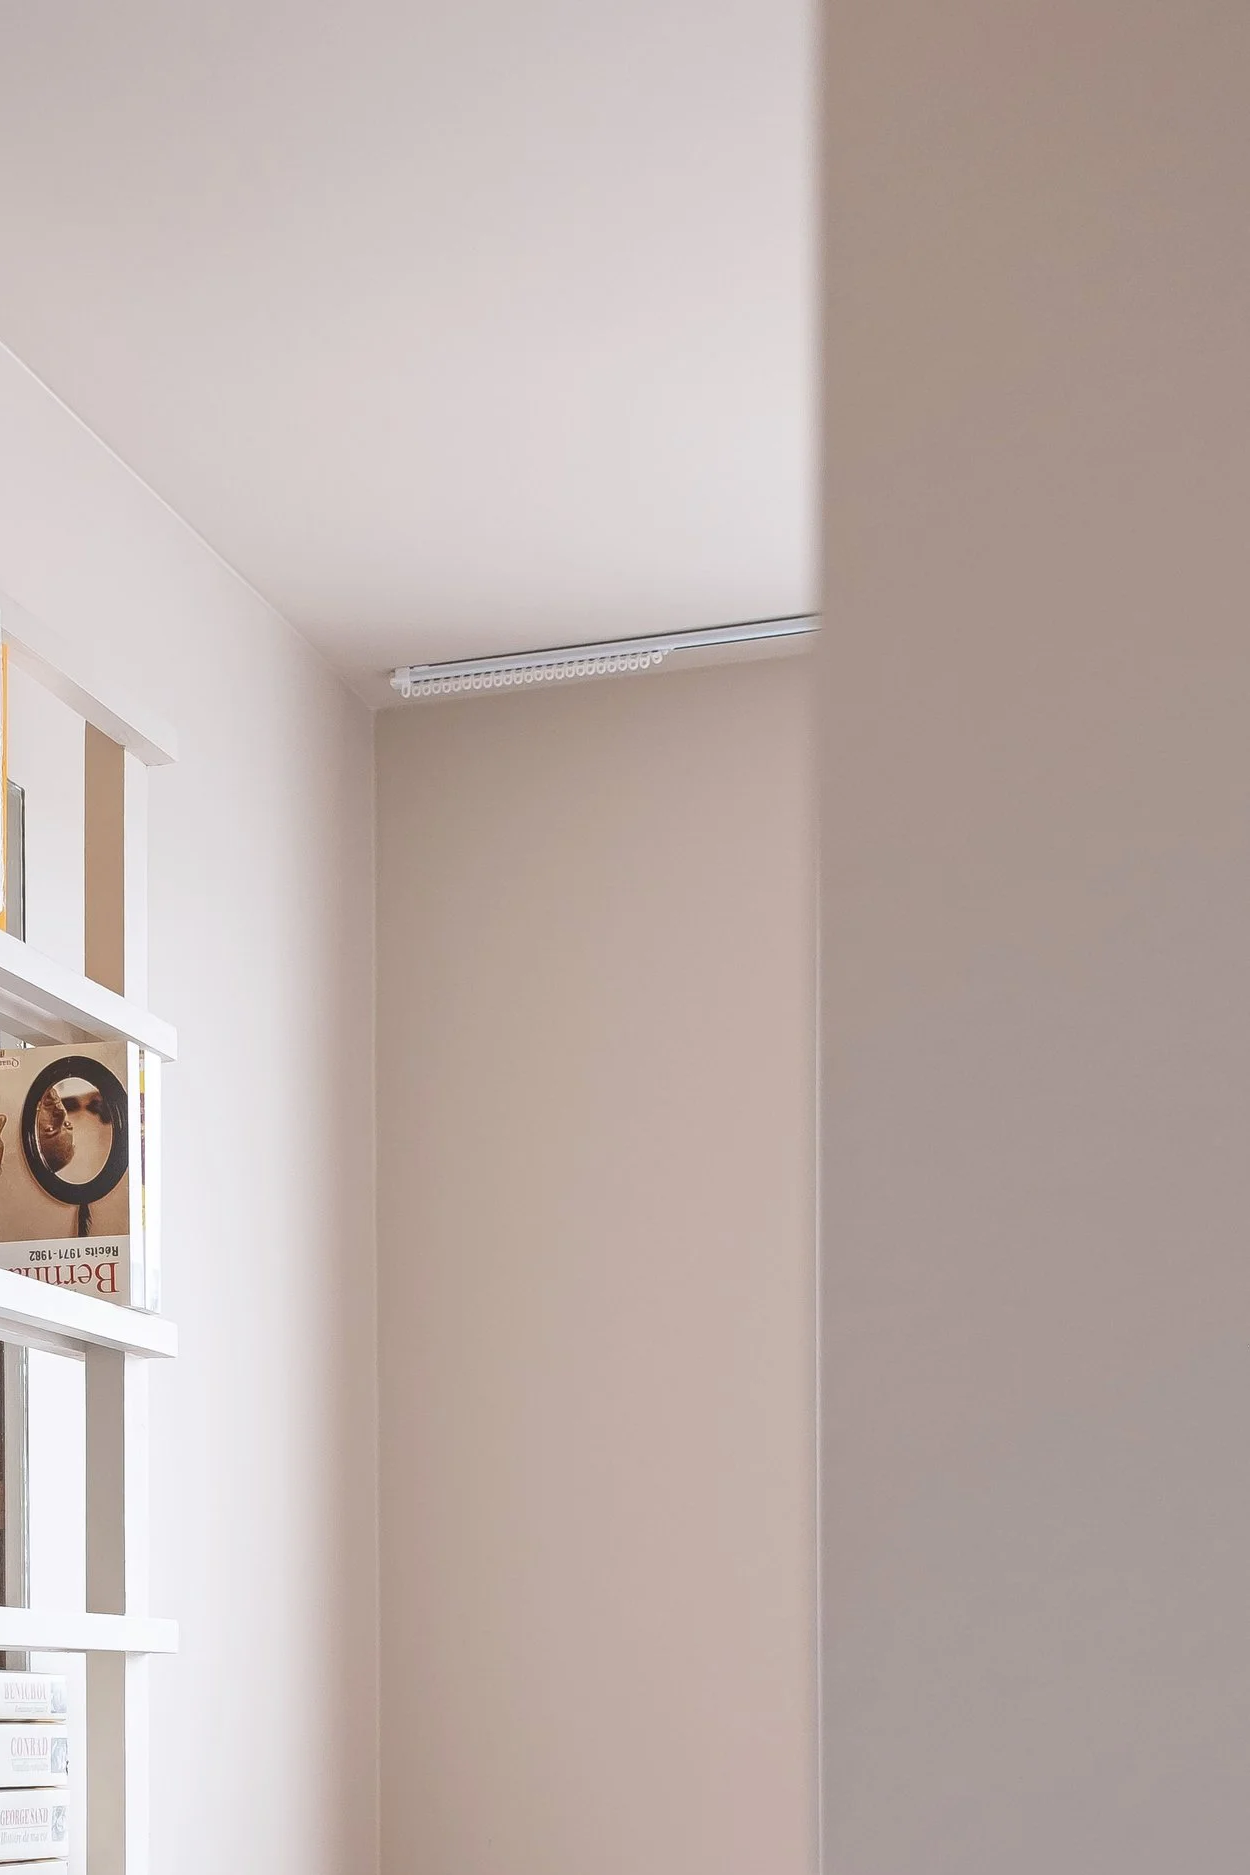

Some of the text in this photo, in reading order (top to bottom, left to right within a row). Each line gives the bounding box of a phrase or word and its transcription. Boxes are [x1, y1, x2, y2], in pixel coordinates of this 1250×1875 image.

[29, 1246, 119, 1262] Récits 1971-1982
[7, 1262, 120, 1294] Bern
[10, 1736, 48, 1757] CONRAD
[0, 1809, 29, 1826] GEORGE
